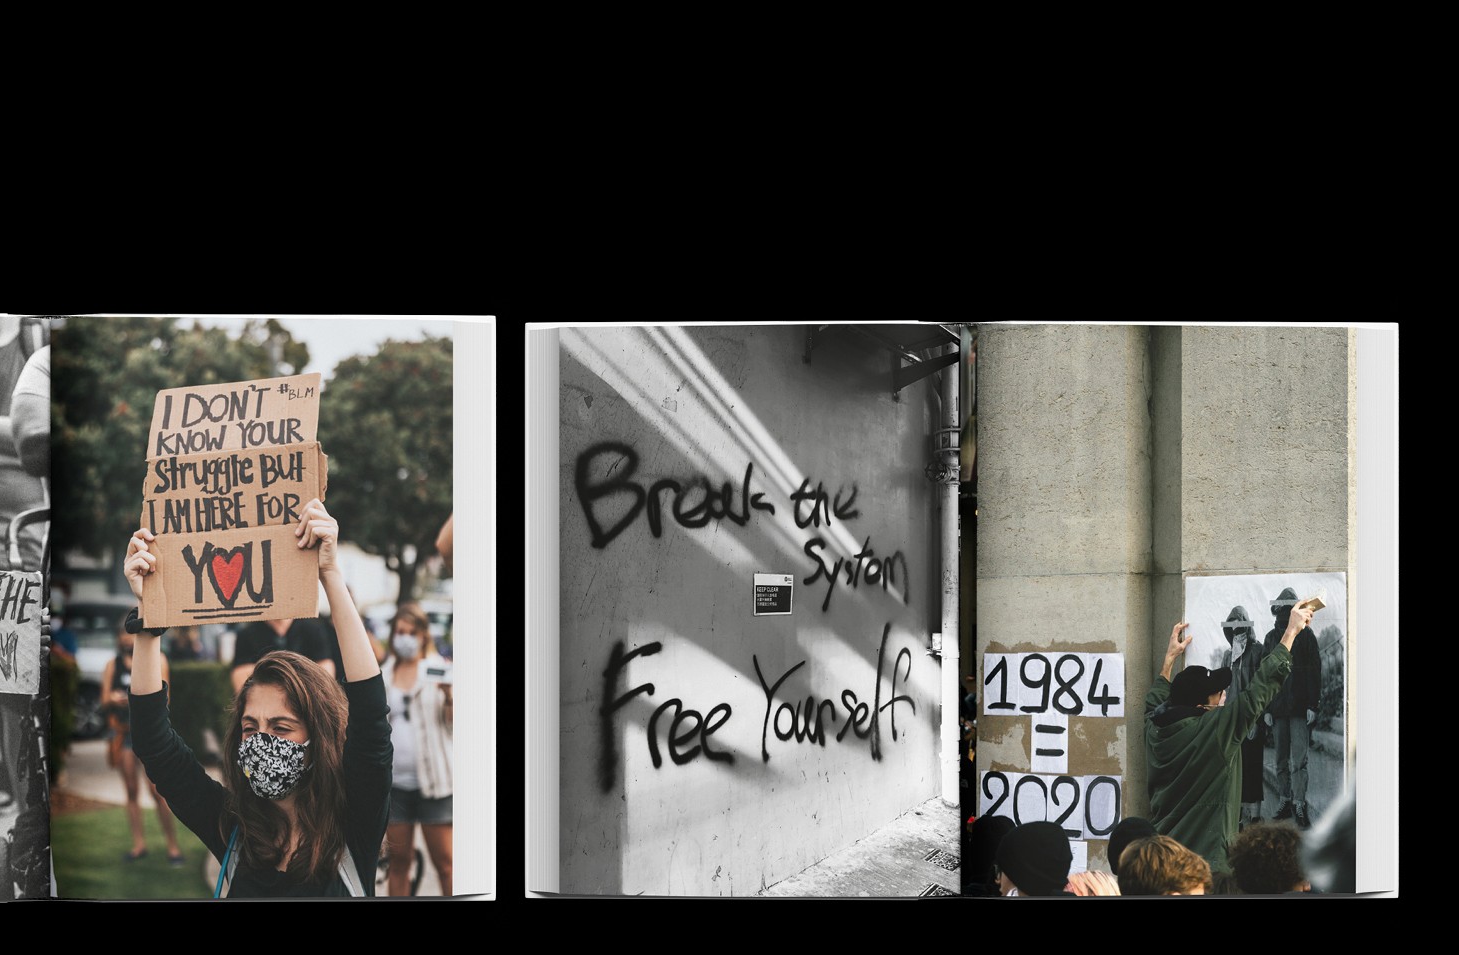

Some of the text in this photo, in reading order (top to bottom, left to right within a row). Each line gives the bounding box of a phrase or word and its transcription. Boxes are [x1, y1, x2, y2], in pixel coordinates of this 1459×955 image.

[162, 384, 271, 430] I DON'T
[277, 383, 315, 400] #BLM
[156, 418, 304, 456] KNOW YOUR
[153, 453, 254, 495] Struggle
[574, 440, 860, 549] Break the
[146, 492, 301, 536] I AM HERE FOR
[600, 622, 916, 793] Free Yourself
[985, 653, 1120, 717] 1984
[982, 771, 1121, 838] 2020
